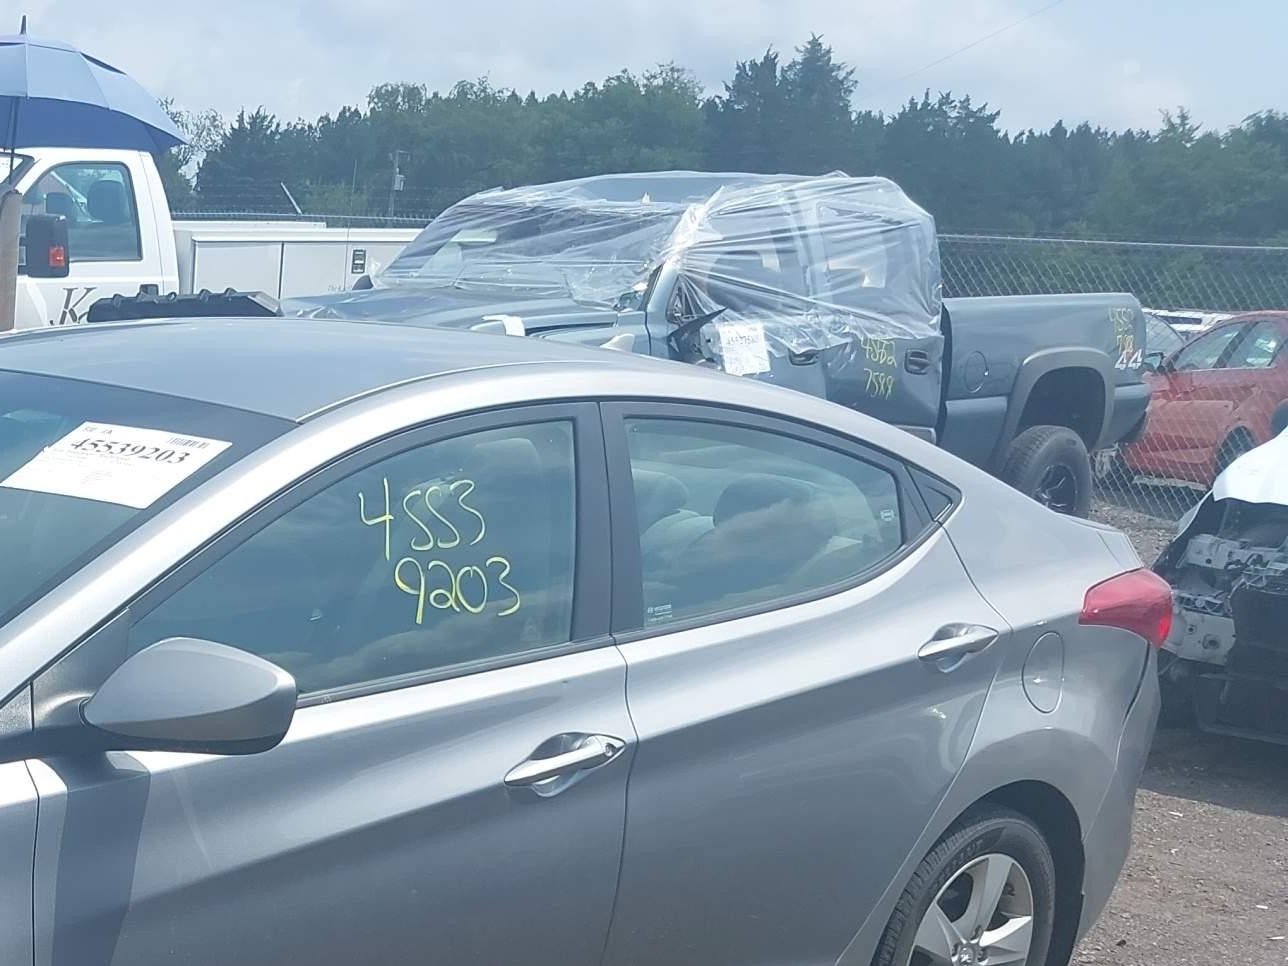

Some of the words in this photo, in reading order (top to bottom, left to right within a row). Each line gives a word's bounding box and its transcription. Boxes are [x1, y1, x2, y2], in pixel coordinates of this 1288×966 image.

[70, 438, 191, 464] 45539203
[357, 476, 487, 562] 4553
[393, 555, 522, 626] 9203
